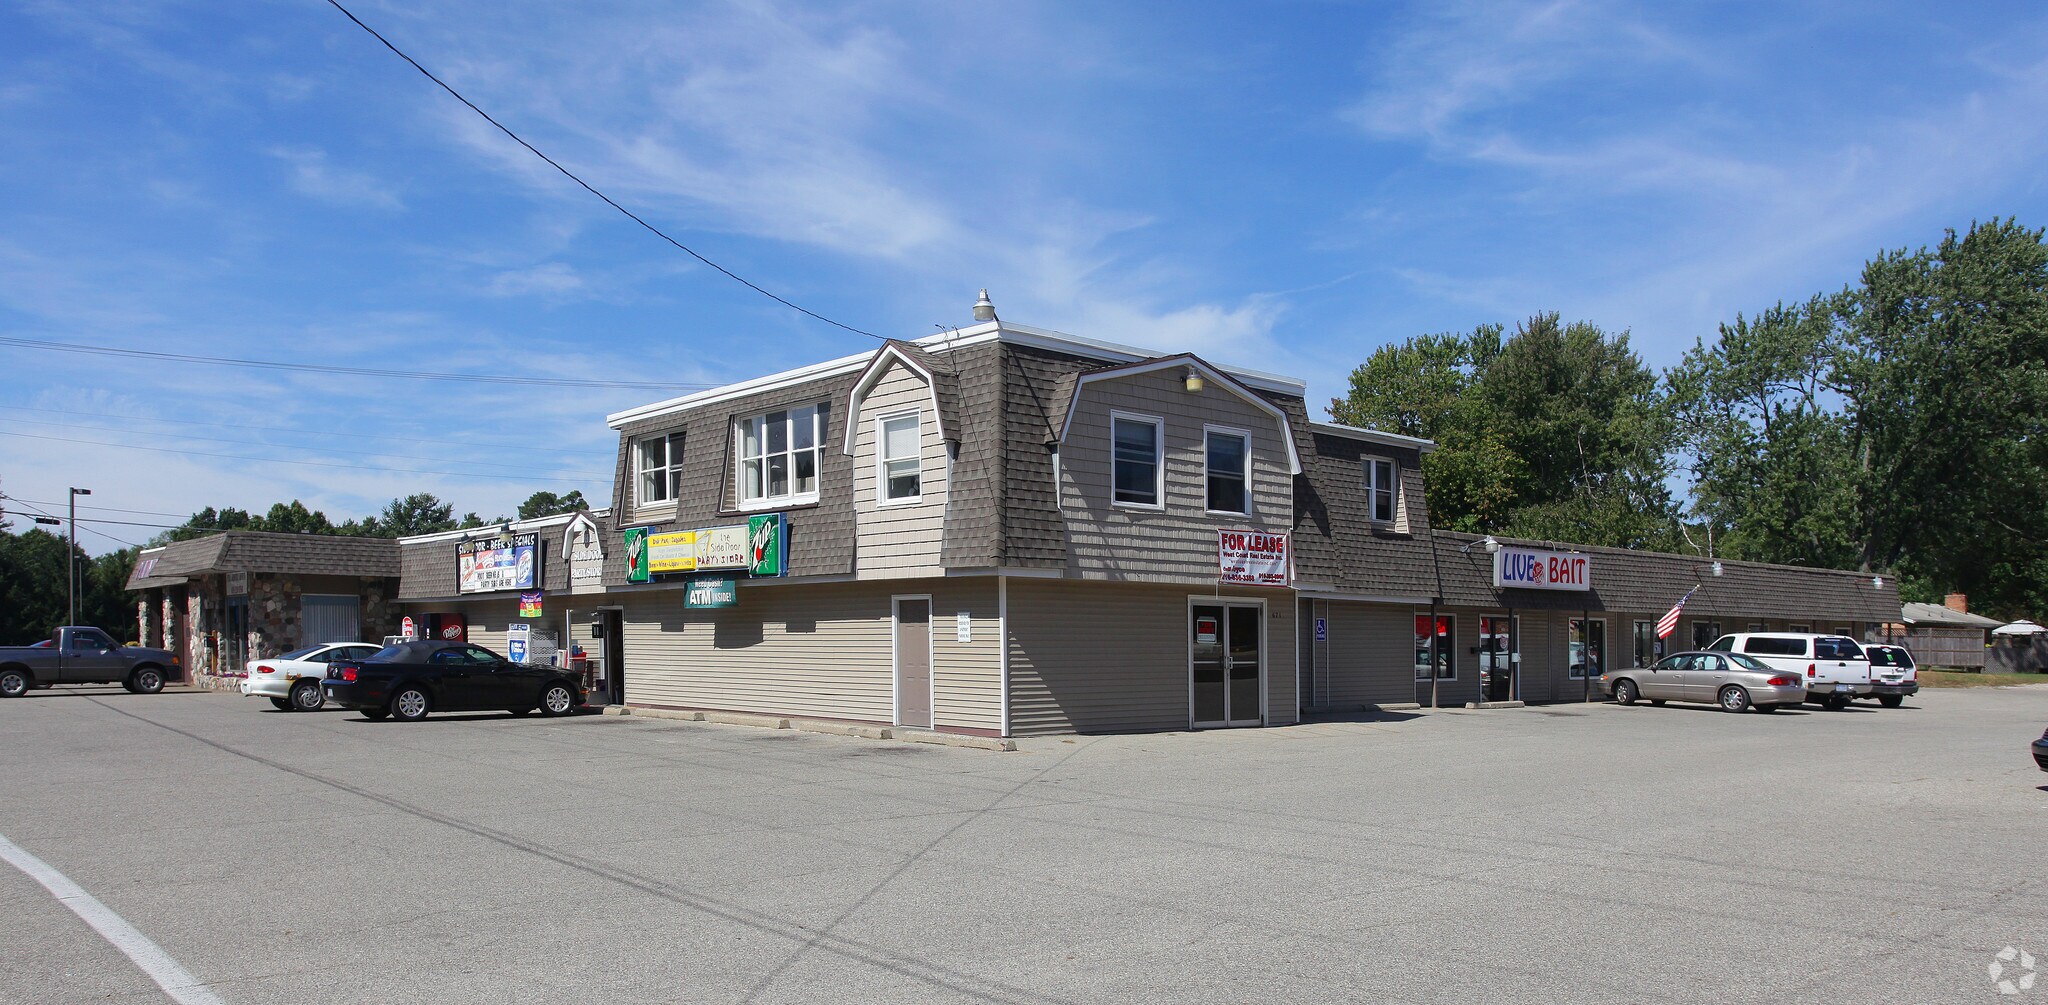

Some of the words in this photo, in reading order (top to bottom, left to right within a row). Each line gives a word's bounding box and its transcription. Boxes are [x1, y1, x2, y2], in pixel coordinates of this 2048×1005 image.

[1221, 533, 1245, 551] FOR
[1248, 535, 1283, 553] LEASE
[1503, 553, 1535, 582] LIVE
[1549, 556, 1586, 585] BAIT
[690, 590, 712, 605] ATM
